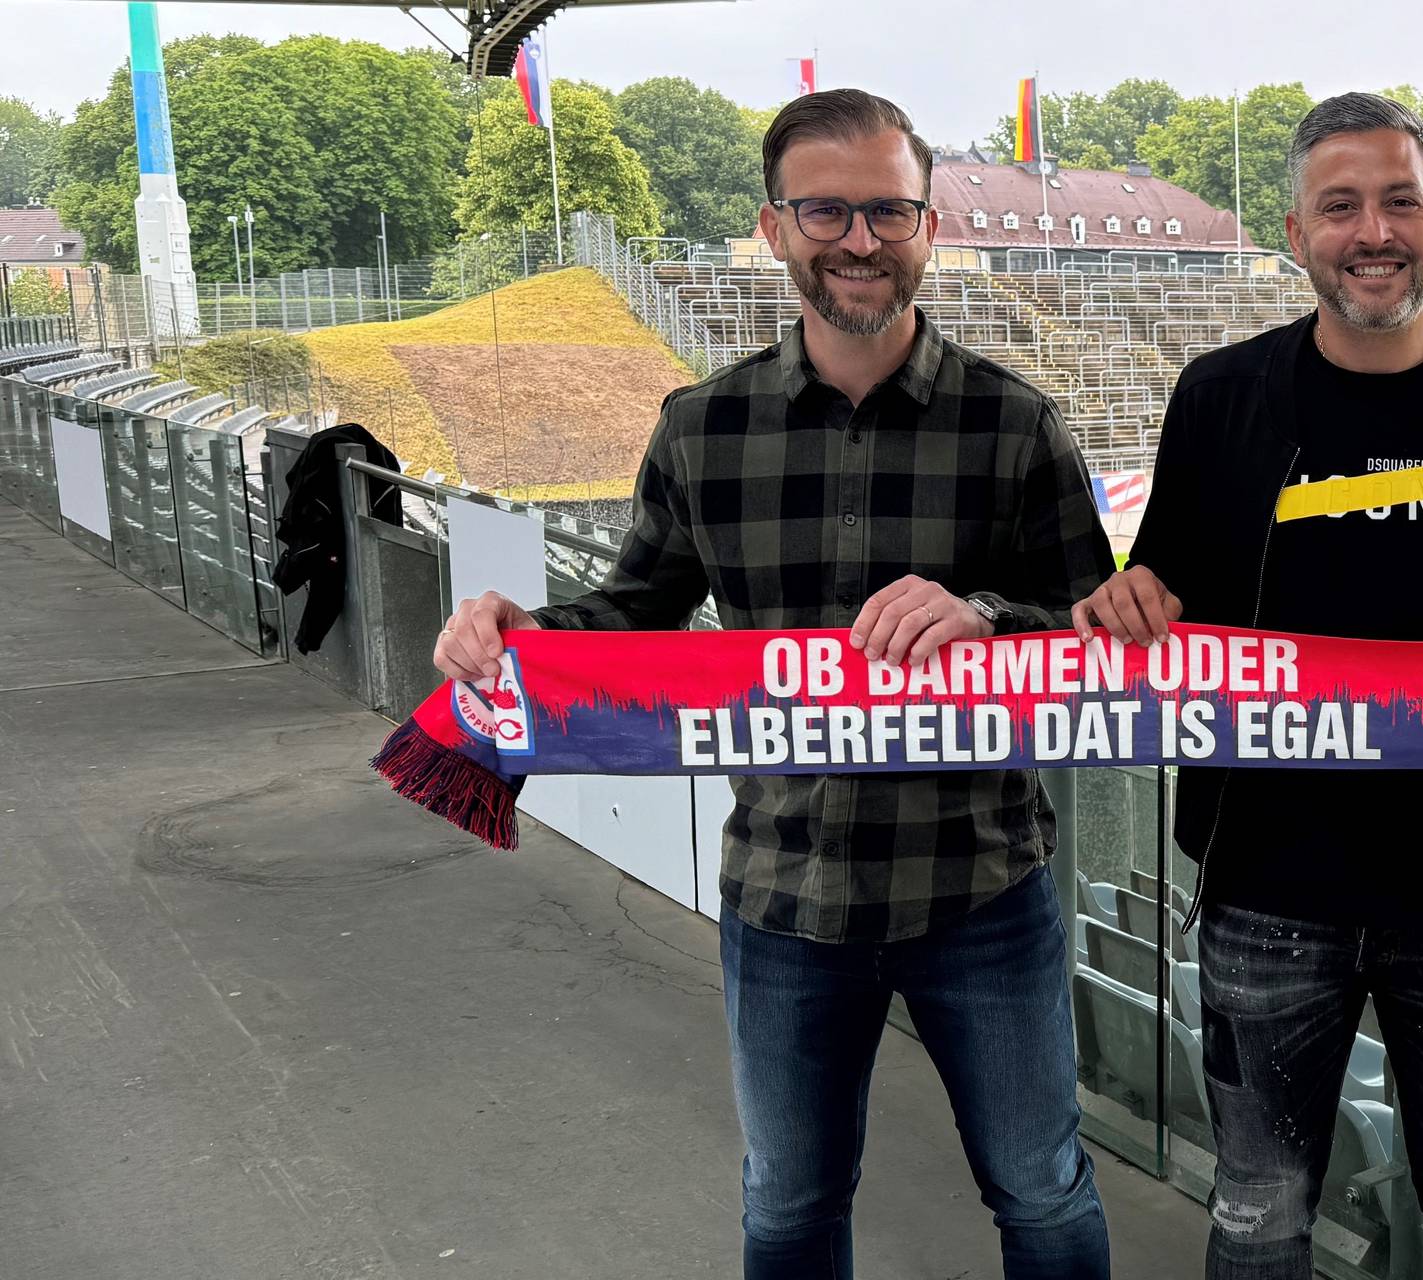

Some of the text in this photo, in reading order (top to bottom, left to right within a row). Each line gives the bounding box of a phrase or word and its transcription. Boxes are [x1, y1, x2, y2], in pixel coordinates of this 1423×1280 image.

[763, 633, 1299, 698] OB BARMEN ODER
[678, 700, 1382, 766] ELBERFELD DAT IS EGAL
